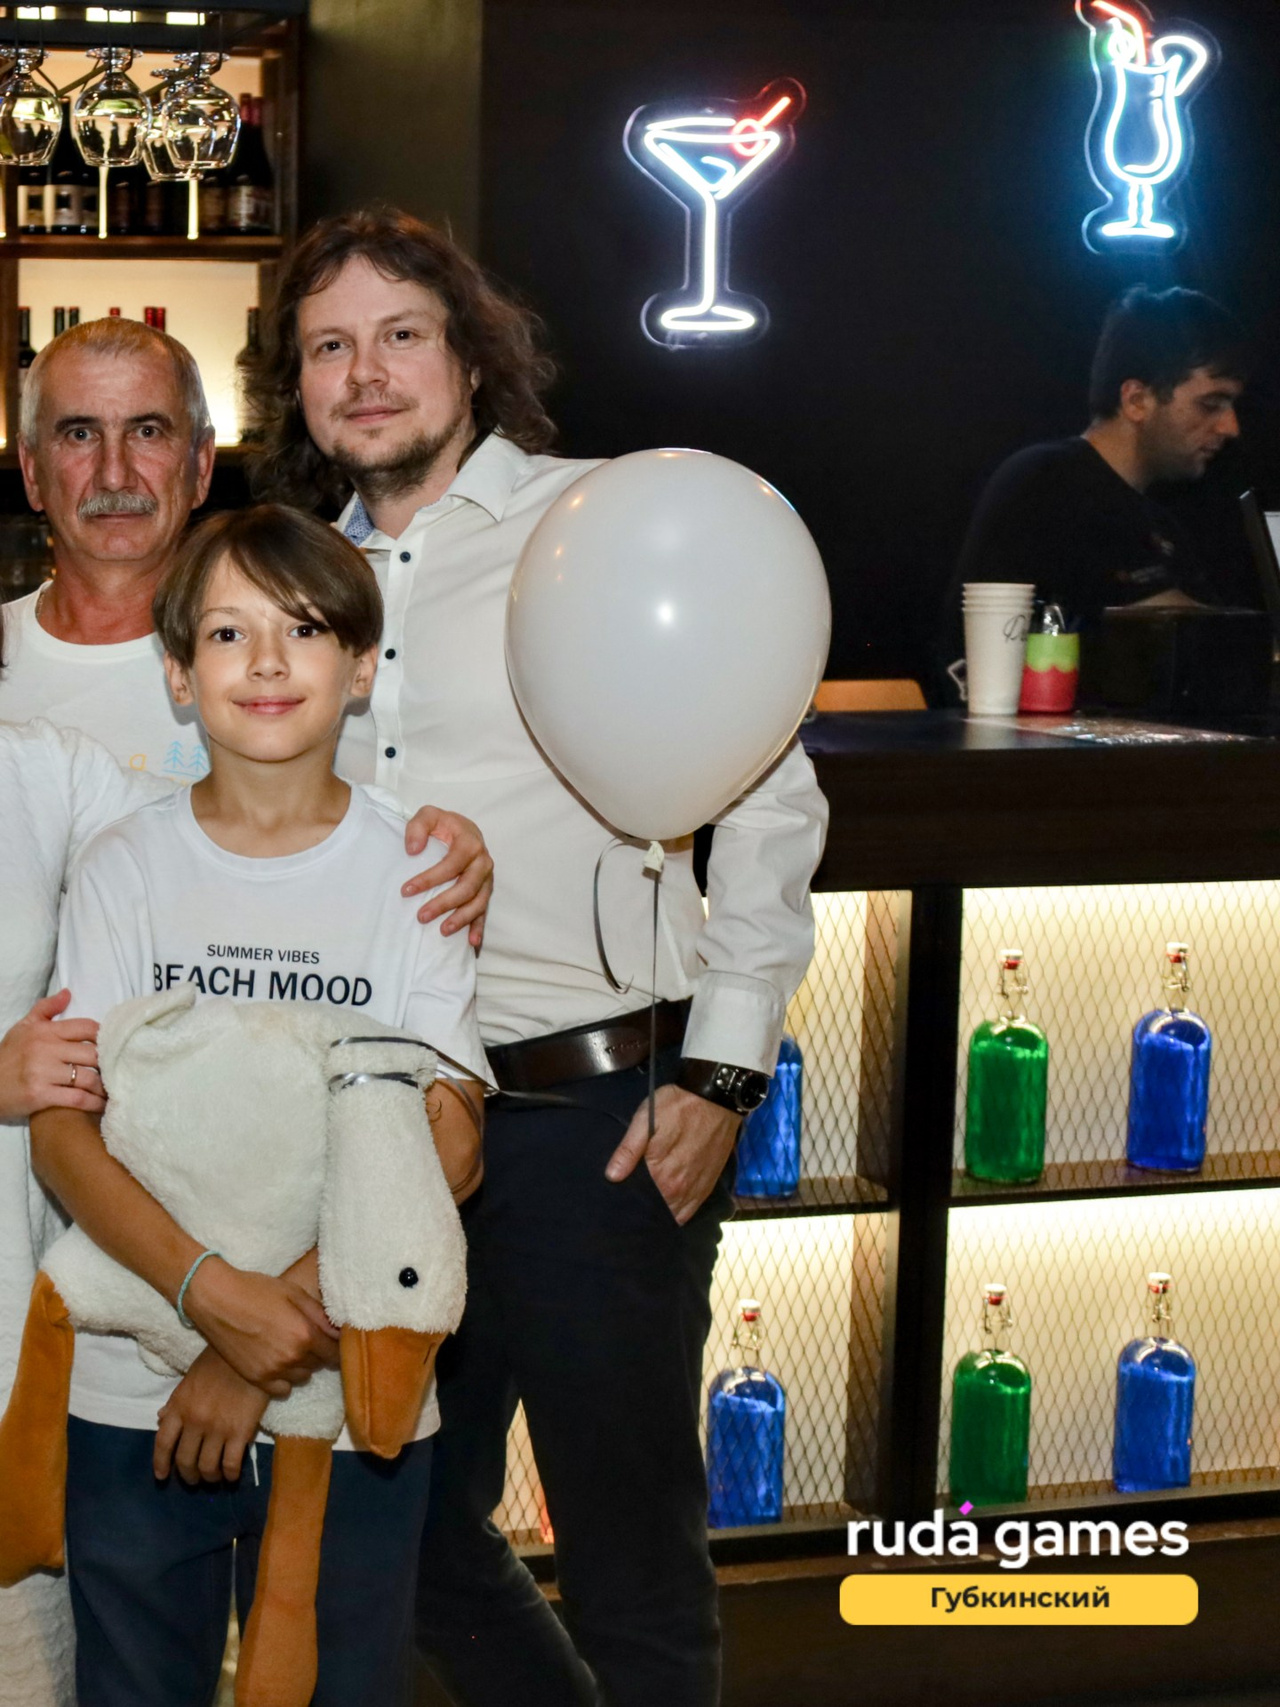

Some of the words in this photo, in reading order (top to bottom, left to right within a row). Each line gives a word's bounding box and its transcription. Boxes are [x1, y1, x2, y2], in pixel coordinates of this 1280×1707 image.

[207, 944, 273, 961] SUMMER
[277, 950, 320, 965] VIBES
[153, 963, 256, 998] BEACH
[269, 971, 373, 1006] MOOD
